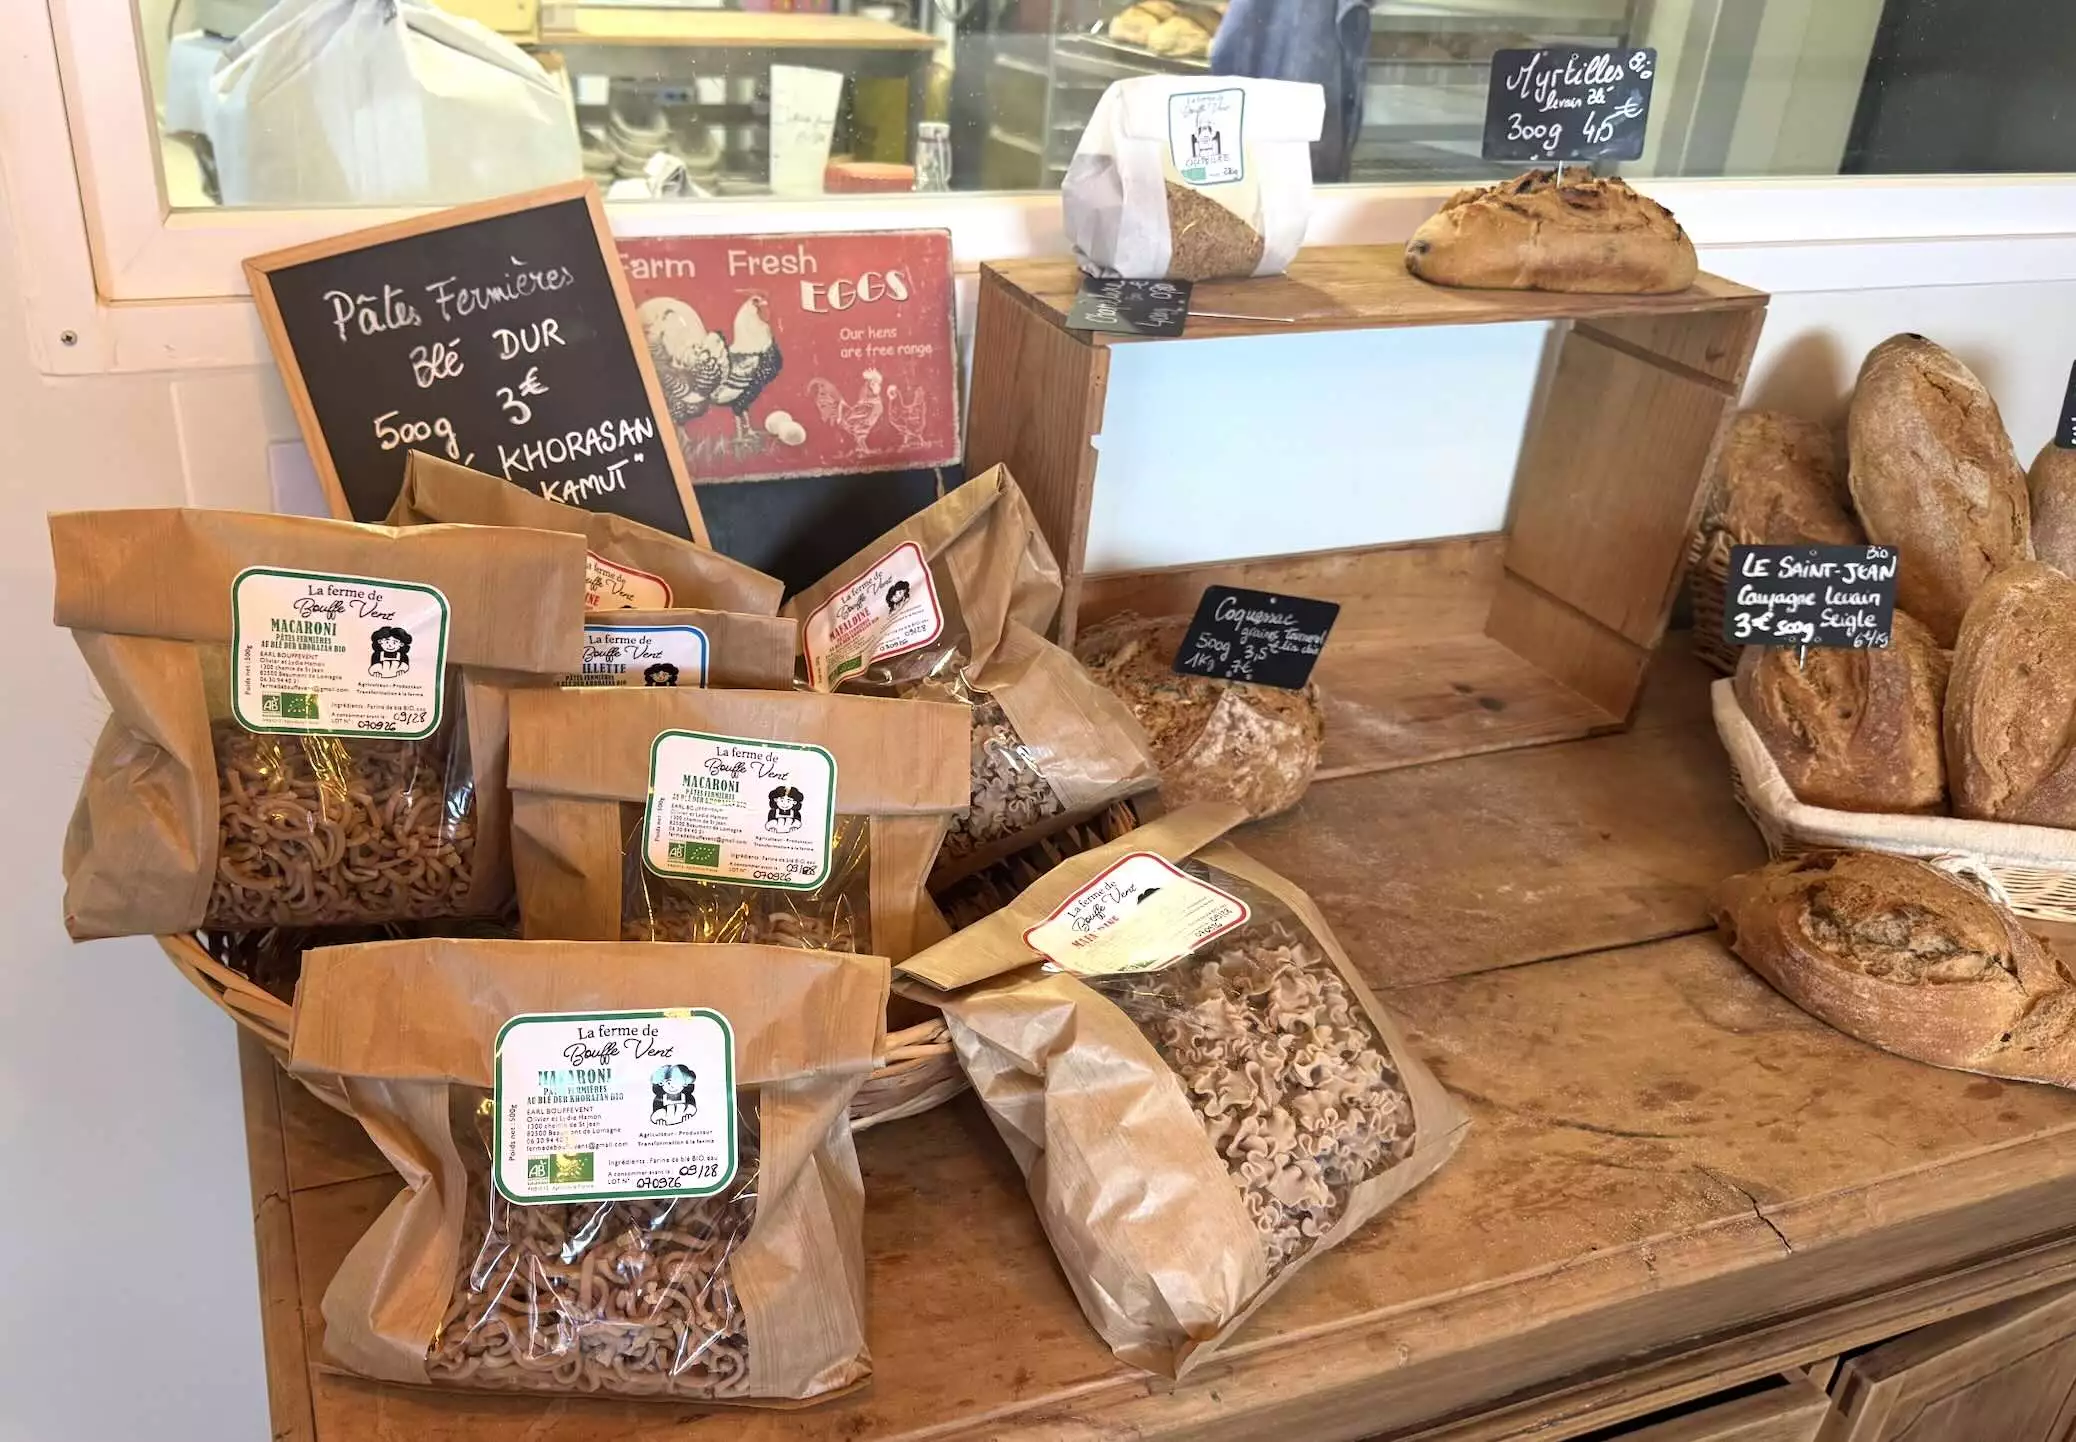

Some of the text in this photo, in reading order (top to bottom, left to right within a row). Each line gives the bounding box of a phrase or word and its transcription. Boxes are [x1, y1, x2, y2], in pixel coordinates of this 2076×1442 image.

[1506, 52, 1624, 103] Myrtilles
[1507, 113, 1563, 150] 300g
[728, 245, 817, 276] Fresh
[323, 255, 575, 343] Pâtes Fermières
[800, 269, 909, 313] EGGS
[840, 326, 897, 340] Our hens
[409, 318, 566, 388] Blé DUR
[840, 342, 933, 359] are free range
[374, 410, 460, 461] 500g
[498, 417, 654, 481] KHORASAN
[1742, 552, 1771, 578] LE
[308, 585, 383, 602] La ferme de
[841, 571, 883, 605] La ferme de
[293, 597, 396, 621] Bouffe Vent
[1819, 607, 1877, 636] Seigle
[271, 618, 337, 636] MACARONI
[588, 634, 652, 645] La ferme de
[583, 645, 663, 662] Bouffe Vent
[1196, 632, 1231, 662] 500g
[582, 663, 627, 674] ILLETTE
[716, 746, 779, 763] La ferme de
[682, 774, 740, 793] MACARONI
[704, 758, 788, 781] Bouffe Vent
[1066, 880, 1118, 920] La ferme de
[1072, 881, 1138, 932] Bouffe Vent
[578, 1024, 659, 1040] La ferme de
[563, 1038, 674, 1066] Bouffe Vent
